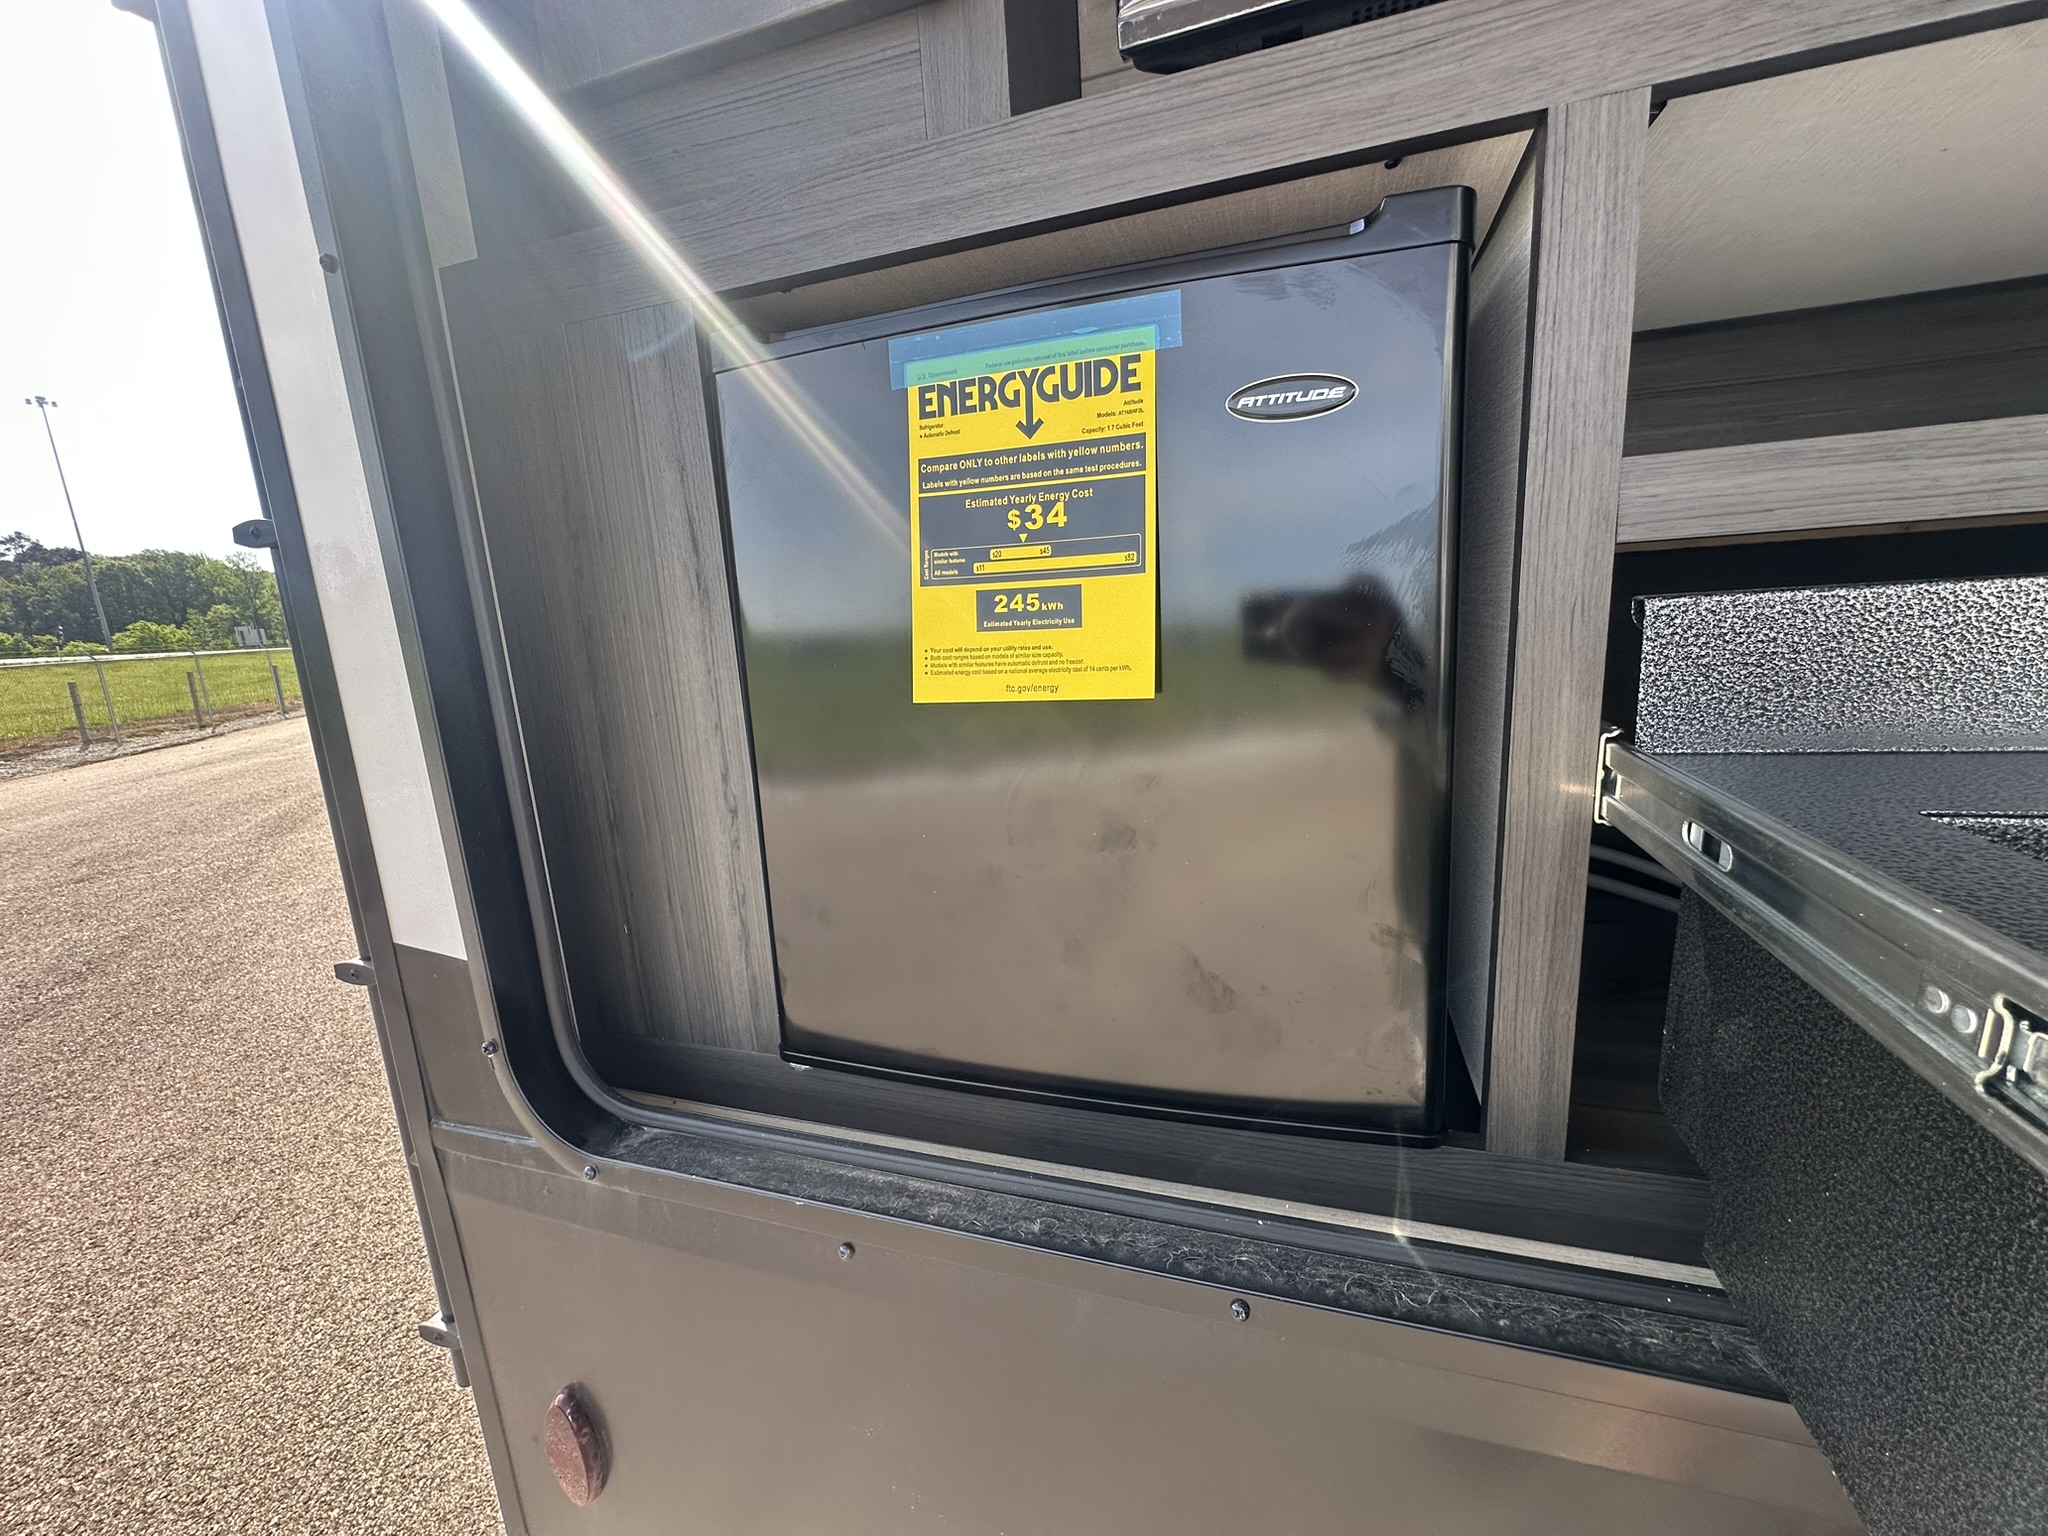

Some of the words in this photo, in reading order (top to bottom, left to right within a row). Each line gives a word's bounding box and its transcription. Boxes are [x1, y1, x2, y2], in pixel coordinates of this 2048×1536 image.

[1032, 353, 1053, 362] removal
[1080, 347, 1095, 355] before
[928, 369, 958, 378] Government
[918, 354, 1141, 420] ENERGYGUIDE
[1237, 386, 1347, 408] ATTITUDE
[1096, 410, 1117, 418] Models:
[919, 423, 944, 431] Refrigerator
[1081, 426, 1106, 434] Capacity:
[1115, 422, 1131, 430] Cubic
[923, 431, 944, 439] Automatic
[920, 462, 958, 473] Compare
[960, 458, 982, 469] ONLY
[994, 455, 1018, 465] other
[1019, 451, 1046, 463] labels
[1047, 449, 1066, 459] with
[1068, 446, 1098, 459] yellow
[1100, 441, 1144, 453] numbers.
[922, 480, 944, 489] Labels
[944, 479, 959, 487] with
[959, 477, 979, 487] yellow
[980, 474, 1009, 484] numbers
[1022, 470, 1042, 479] based
[1053, 468, 1064, 476] the
[1065, 466, 1084, 475] same
[1084, 464, 1098, 473] test
[1099, 461, 1142, 472] procedures.
[965, 496, 1008, 509] Estimated
[1009, 493, 1037, 504] Yearly
[1038, 491, 1070, 502] Energy
[1072, 488, 1093, 498] Cost
[1007, 501, 1067, 531] $34
[993, 593, 1040, 613] 245
[1041, 602, 1064, 611] kWh
[983, 620, 1013, 628] Estimated
[1013, 619, 1032, 627] Yearly
[1032, 618, 1062, 626] Electricity
[1005, 684, 1059, 694] ftc.gov/energy
